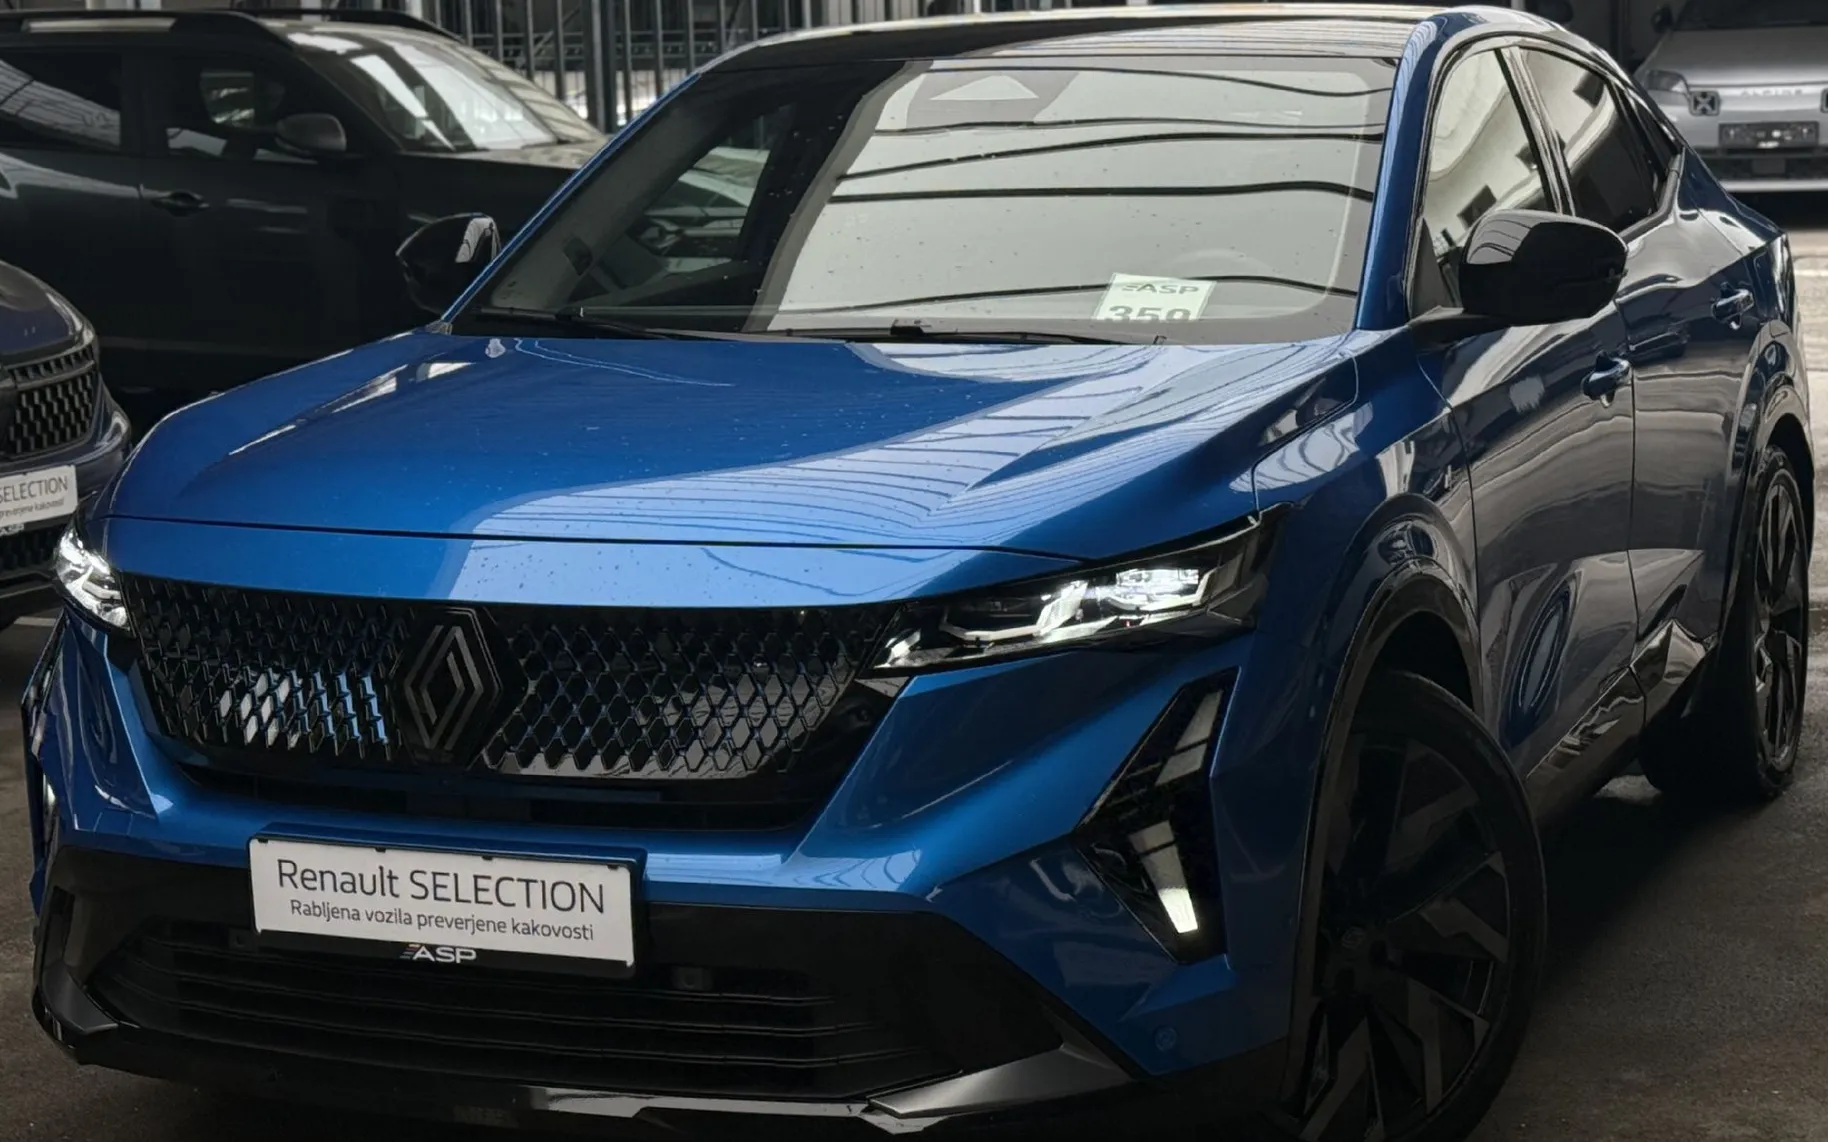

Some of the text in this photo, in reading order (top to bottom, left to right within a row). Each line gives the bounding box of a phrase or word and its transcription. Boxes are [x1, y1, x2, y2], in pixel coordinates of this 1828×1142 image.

[277, 858, 605, 914] Renault SELECTION
[290, 899, 594, 941] Rabljena vozila preverjene kakovosti
[410, 945, 477, 964] ASP
